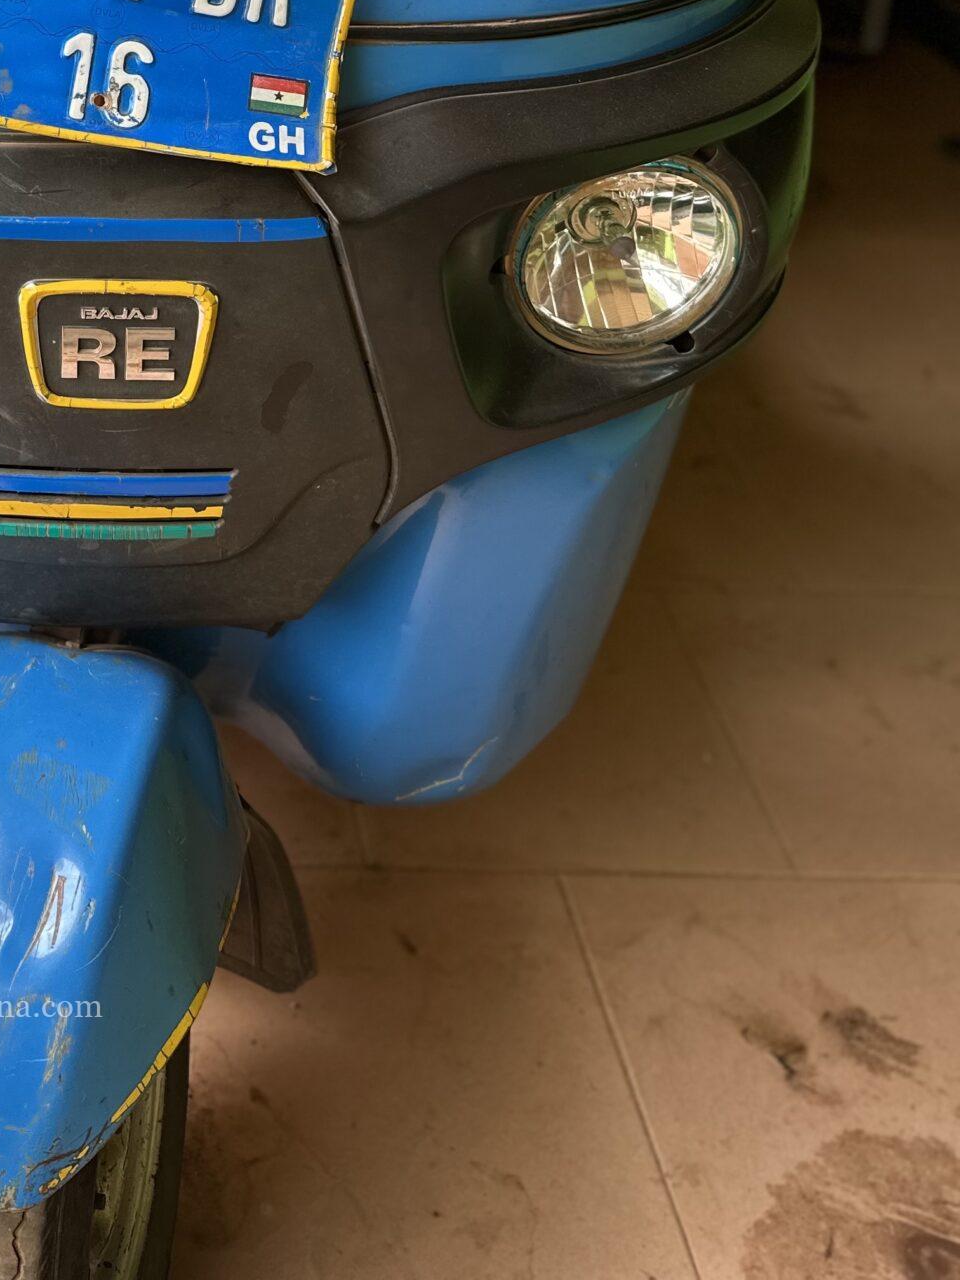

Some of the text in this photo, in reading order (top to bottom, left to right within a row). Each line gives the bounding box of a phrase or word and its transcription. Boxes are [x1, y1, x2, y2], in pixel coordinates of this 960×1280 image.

[63, 32, 155, 129] 16
[248, 122, 305, 157] GH
[80, 306, 159, 321] BAJAJ
[60, 325, 176, 381] RE
